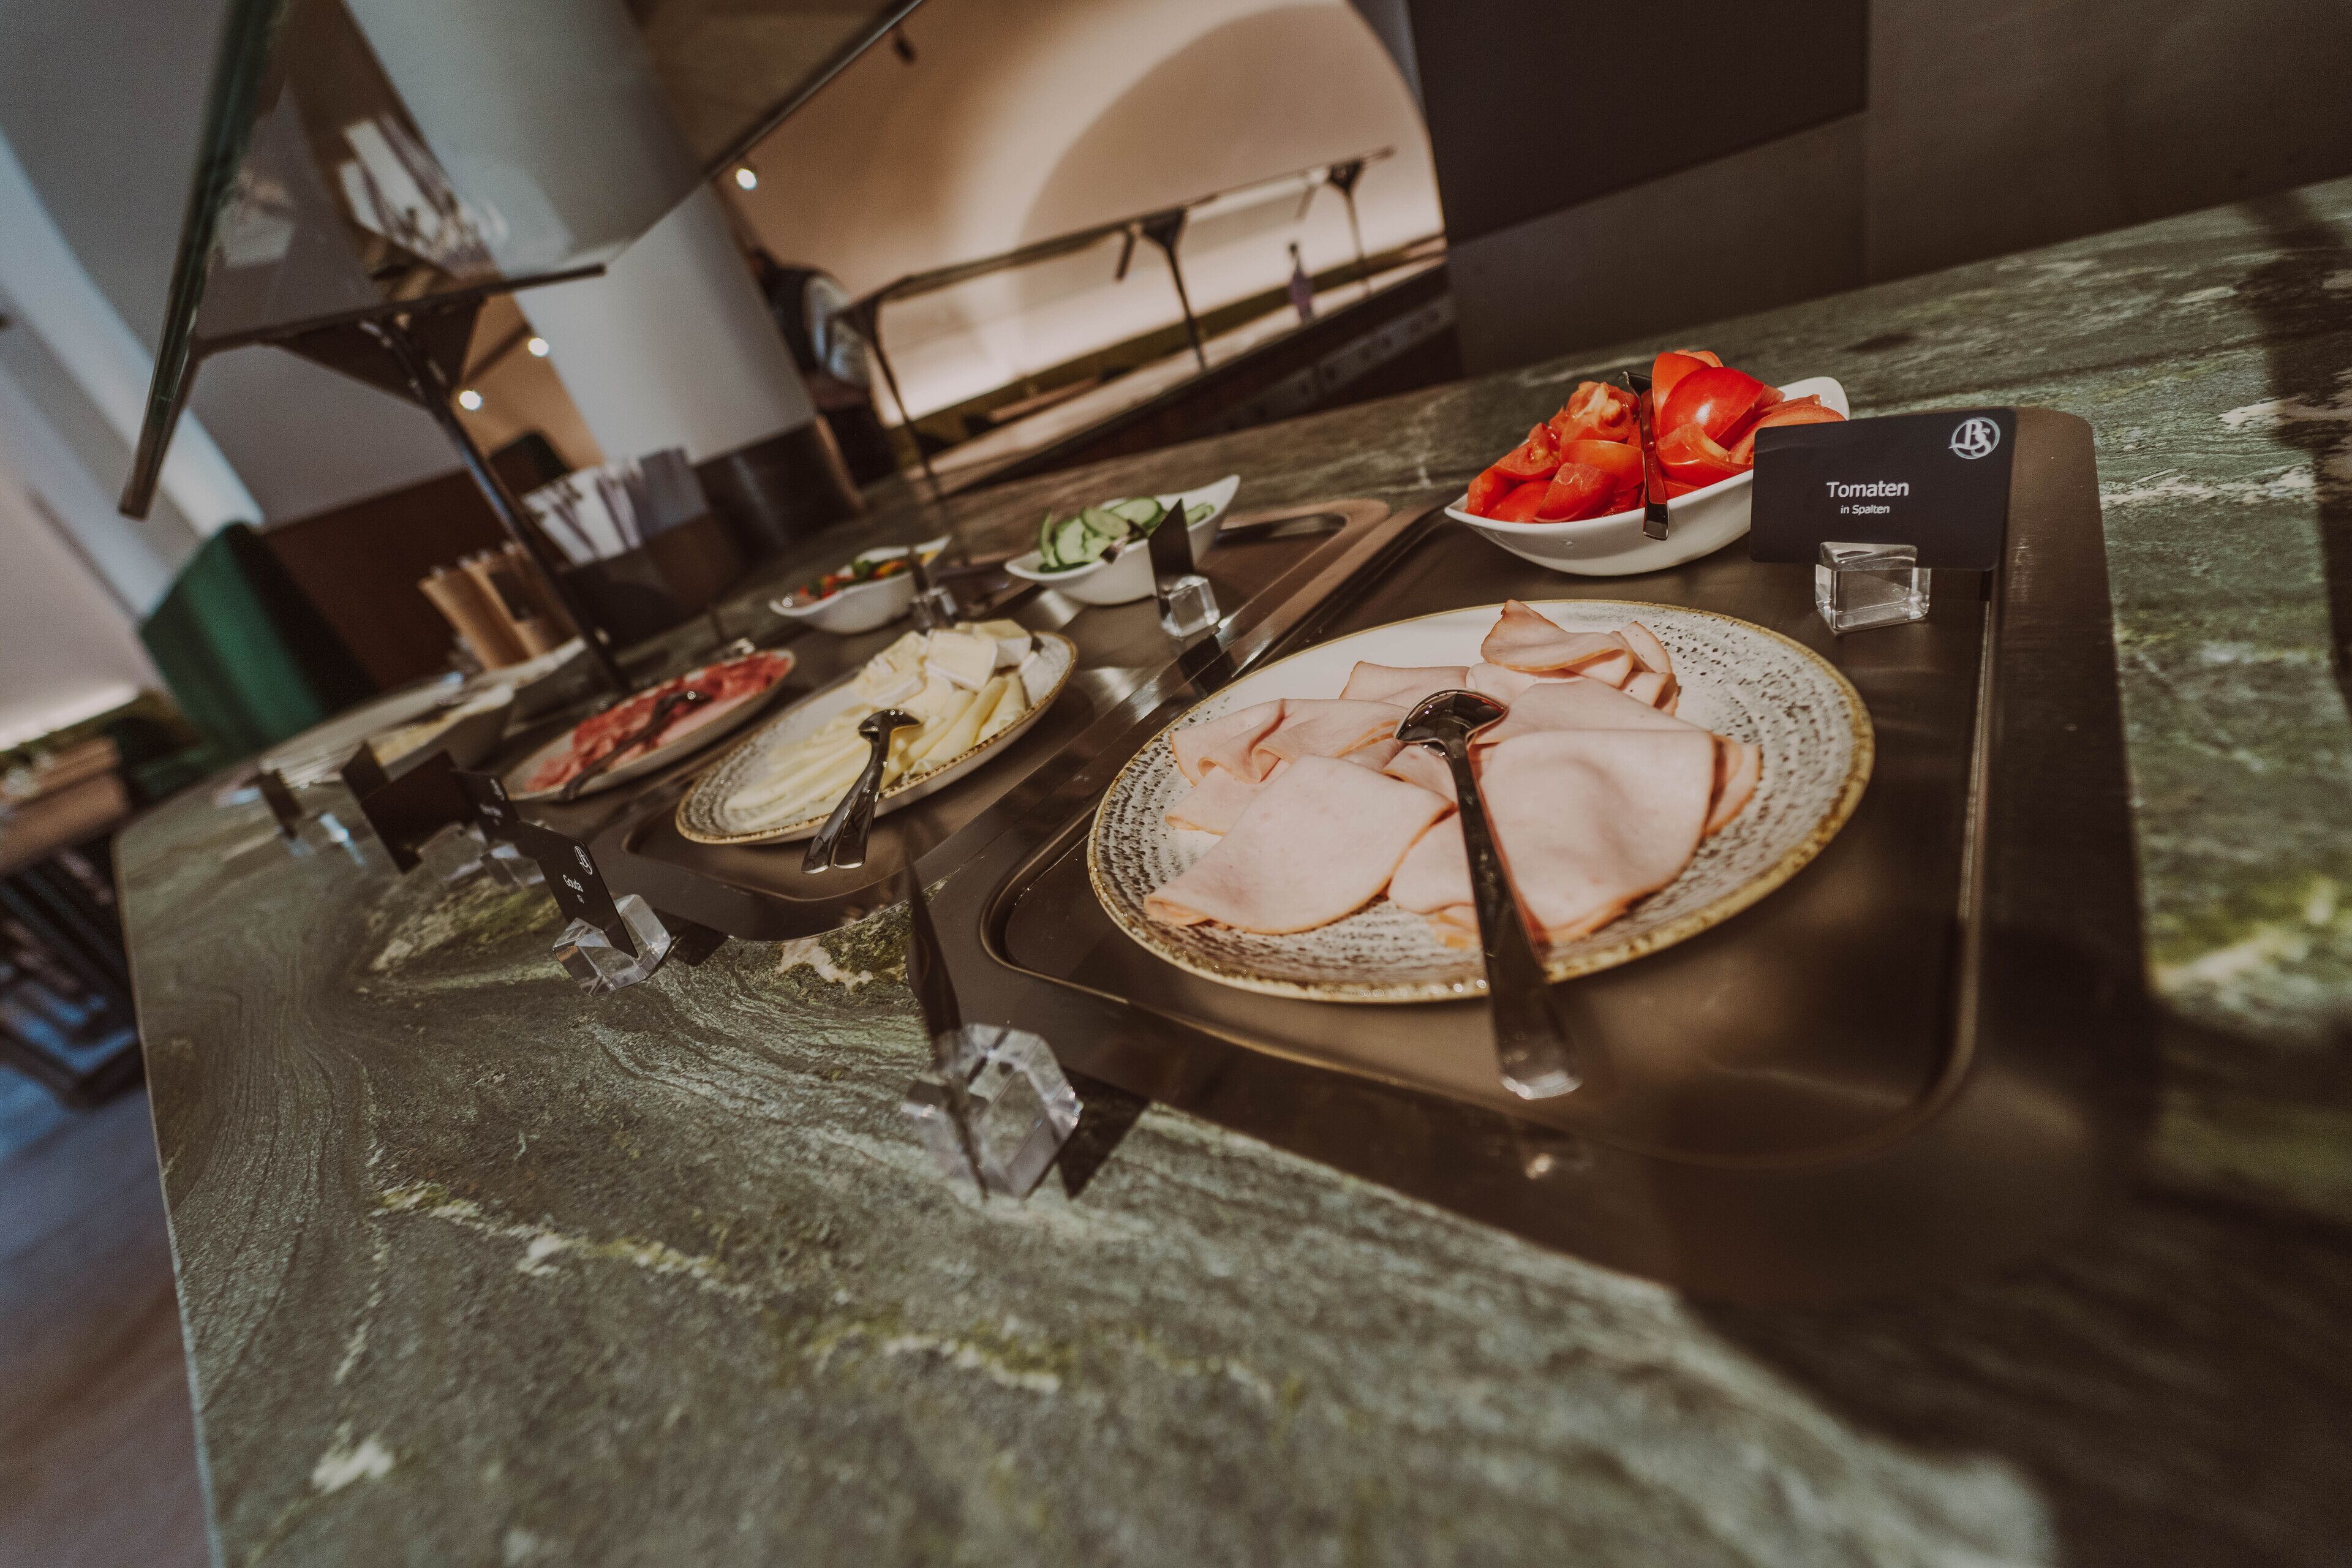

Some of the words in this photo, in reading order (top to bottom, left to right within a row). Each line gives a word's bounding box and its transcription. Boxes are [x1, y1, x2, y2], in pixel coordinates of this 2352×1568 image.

[1826, 480, 1909, 497] Tomaten
[1840, 505, 1850, 514] in
[1852, 504, 1890, 516] Spalten
[563, 875, 584, 892] Gouda
